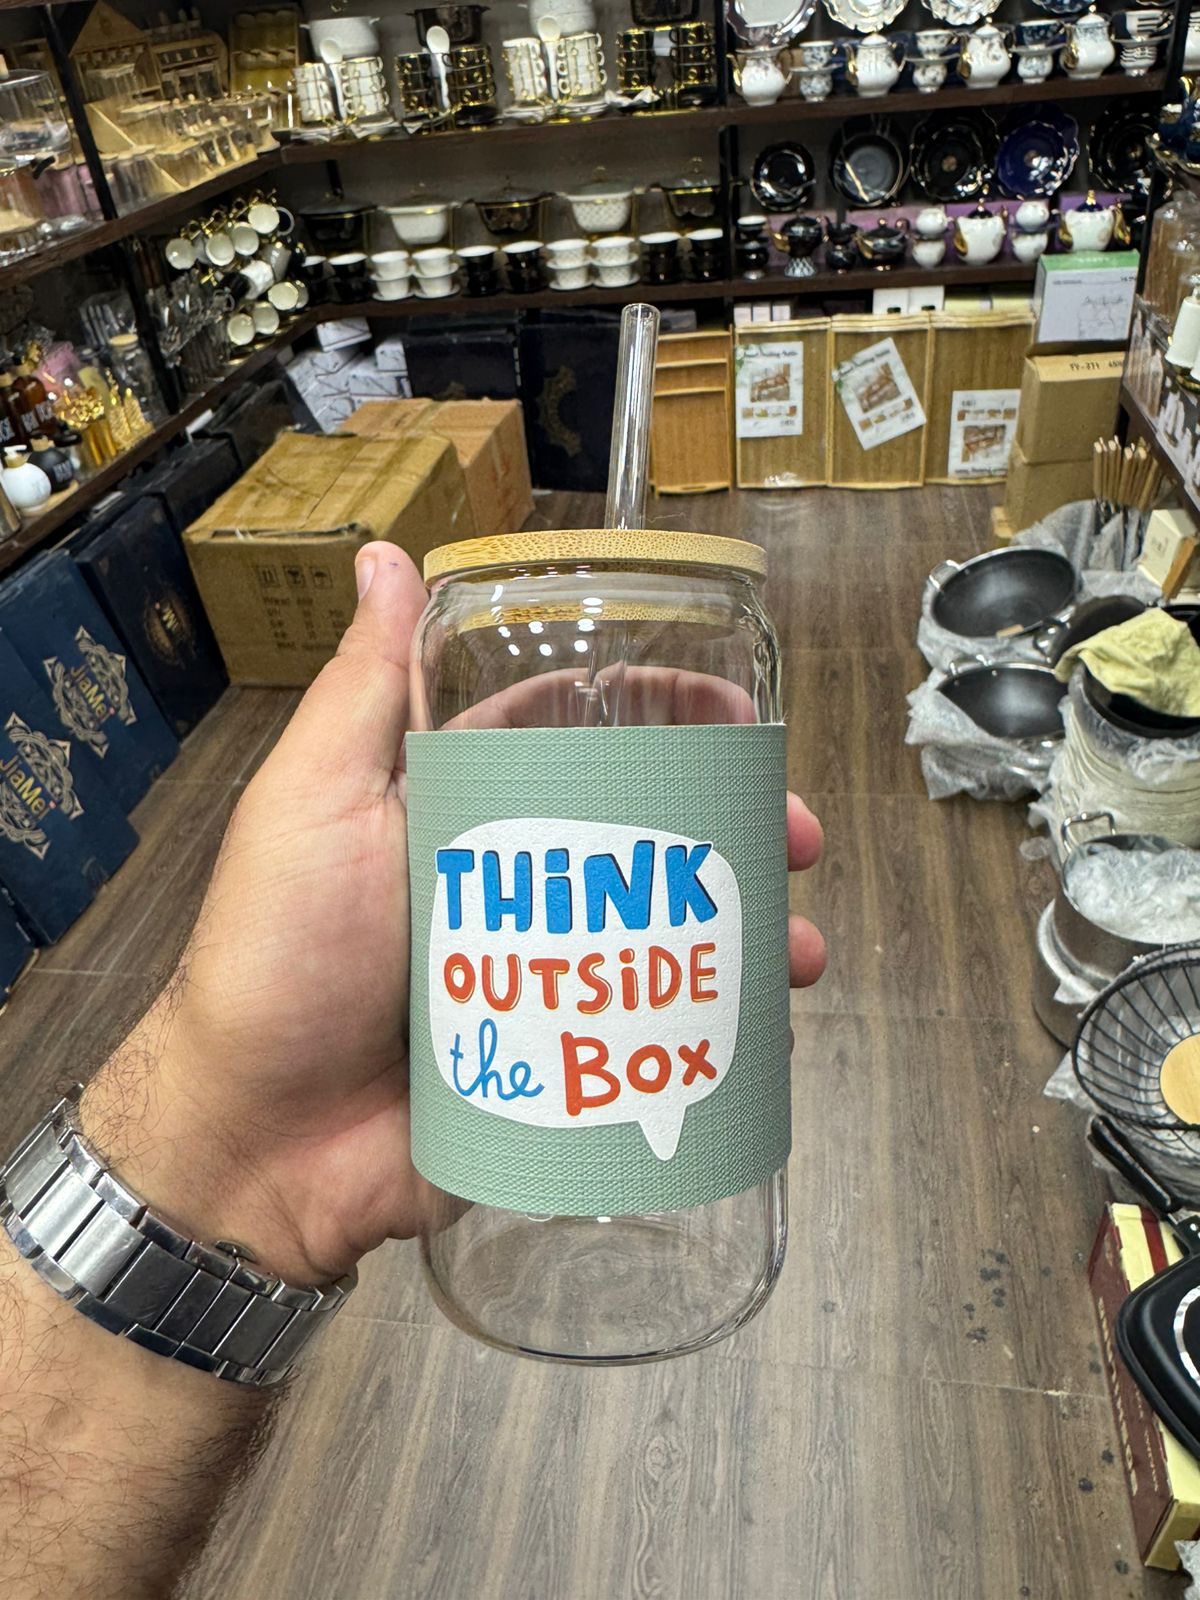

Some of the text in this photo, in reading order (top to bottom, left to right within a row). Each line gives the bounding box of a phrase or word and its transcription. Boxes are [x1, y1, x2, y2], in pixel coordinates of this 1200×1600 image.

[70, 663, 116, 725] JiaMei
[0, 754, 57, 820] JiaMei
[449, 1018, 545, 1101] the
